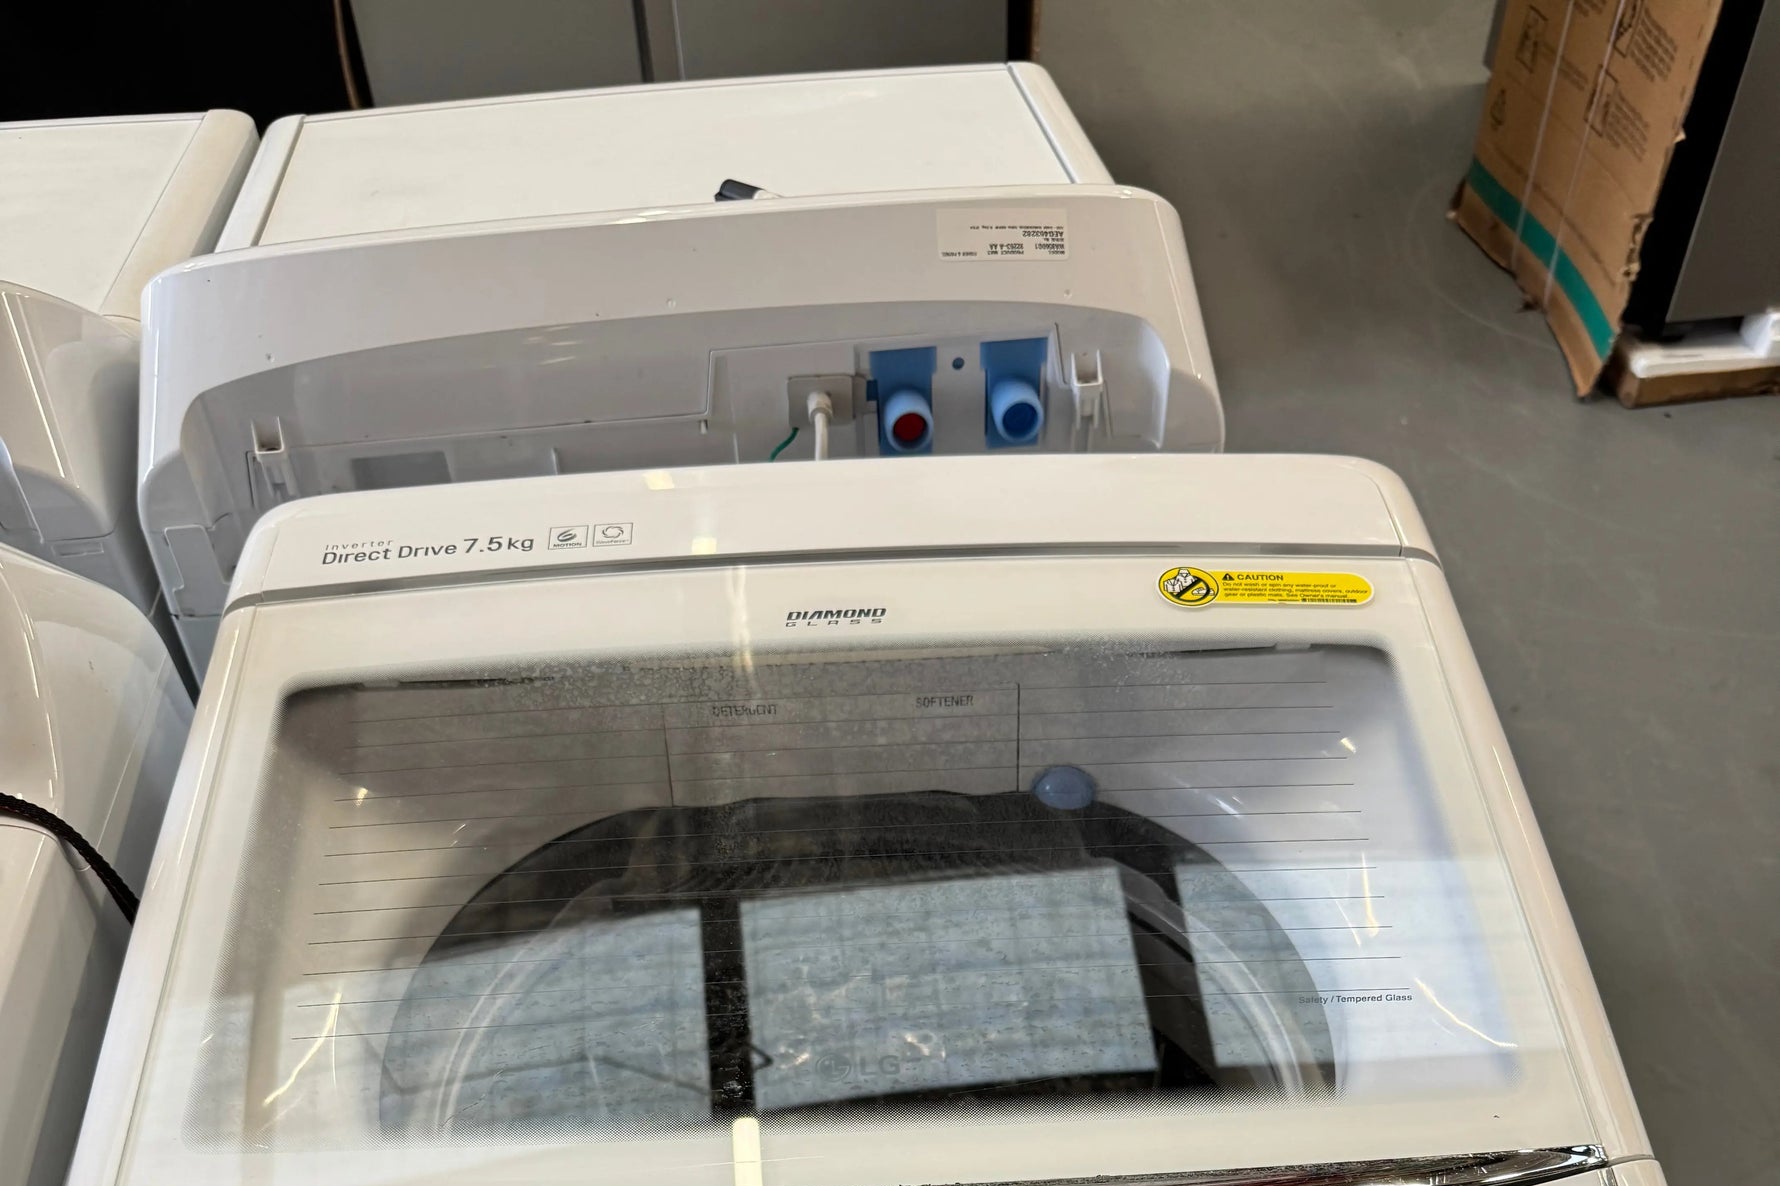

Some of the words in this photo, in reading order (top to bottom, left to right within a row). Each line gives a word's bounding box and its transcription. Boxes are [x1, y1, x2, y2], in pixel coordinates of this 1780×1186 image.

[553, 541, 582, 549] MOTION
[321, 549, 392, 565] Direct
[397, 541, 457, 559] Drive
[786, 607, 887, 621] DIAMOND
[785, 618, 883, 627] GLASS
[915, 695, 974, 708] SOFTENER
[1299, 996, 1328, 1004] Safety
[1336, 994, 1383, 1004] Tempered
[1385, 993, 1413, 1002] Glass
